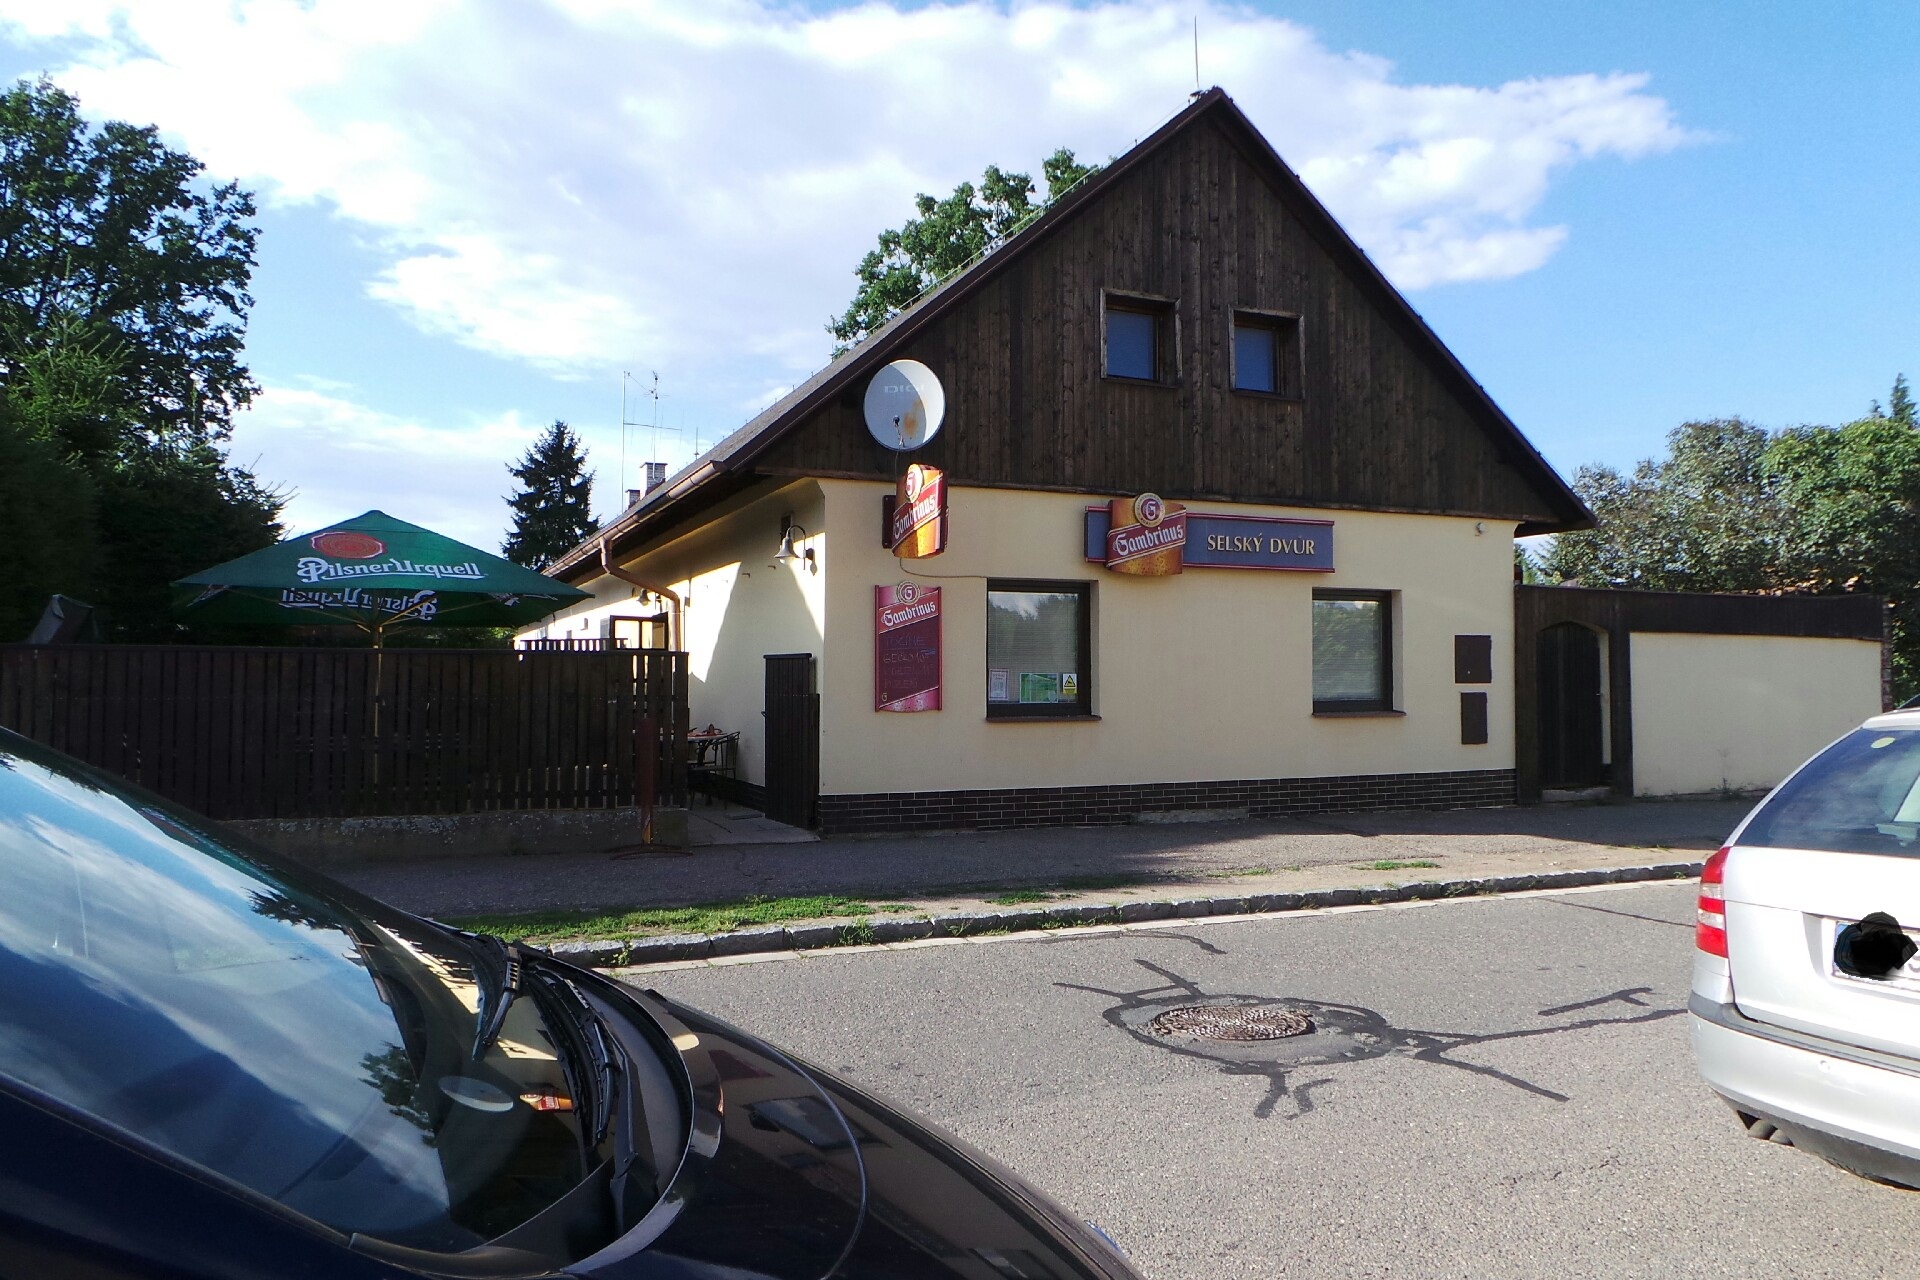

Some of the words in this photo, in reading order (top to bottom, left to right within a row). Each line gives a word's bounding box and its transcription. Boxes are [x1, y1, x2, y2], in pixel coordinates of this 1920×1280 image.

[894, 494, 936, 540] Gambrinus
[1113, 524, 1184, 556] Gambrinus
[1207, 532, 1263, 552] SELSKÝ
[296, 557, 396, 583] Pilsner
[389, 558, 482, 579] Urquell
[881, 601, 936, 626] Gambrinus
